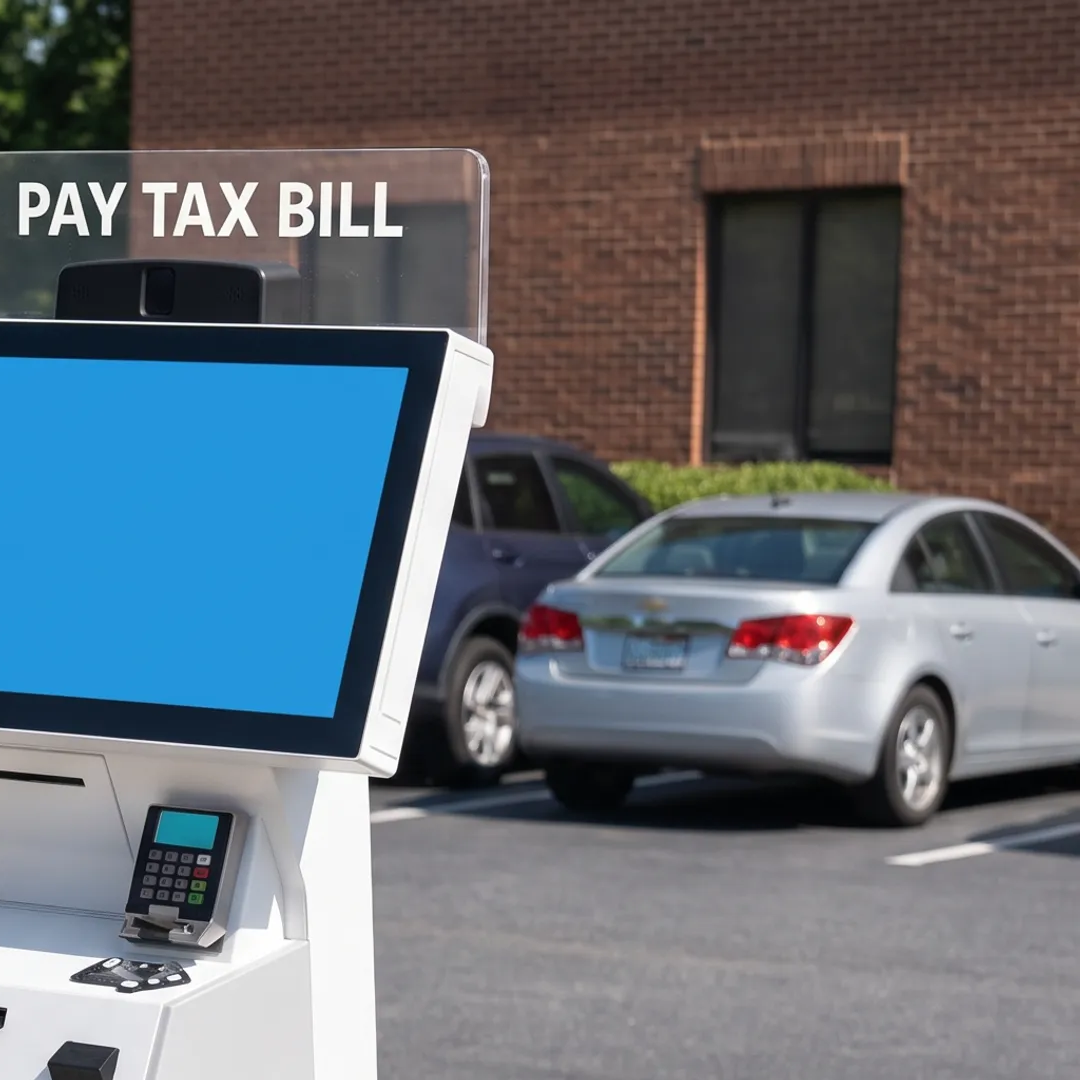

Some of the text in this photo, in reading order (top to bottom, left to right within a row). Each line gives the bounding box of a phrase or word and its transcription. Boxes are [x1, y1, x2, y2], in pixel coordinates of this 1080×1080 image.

[18, 181, 404, 238] PAY TAX BILL
